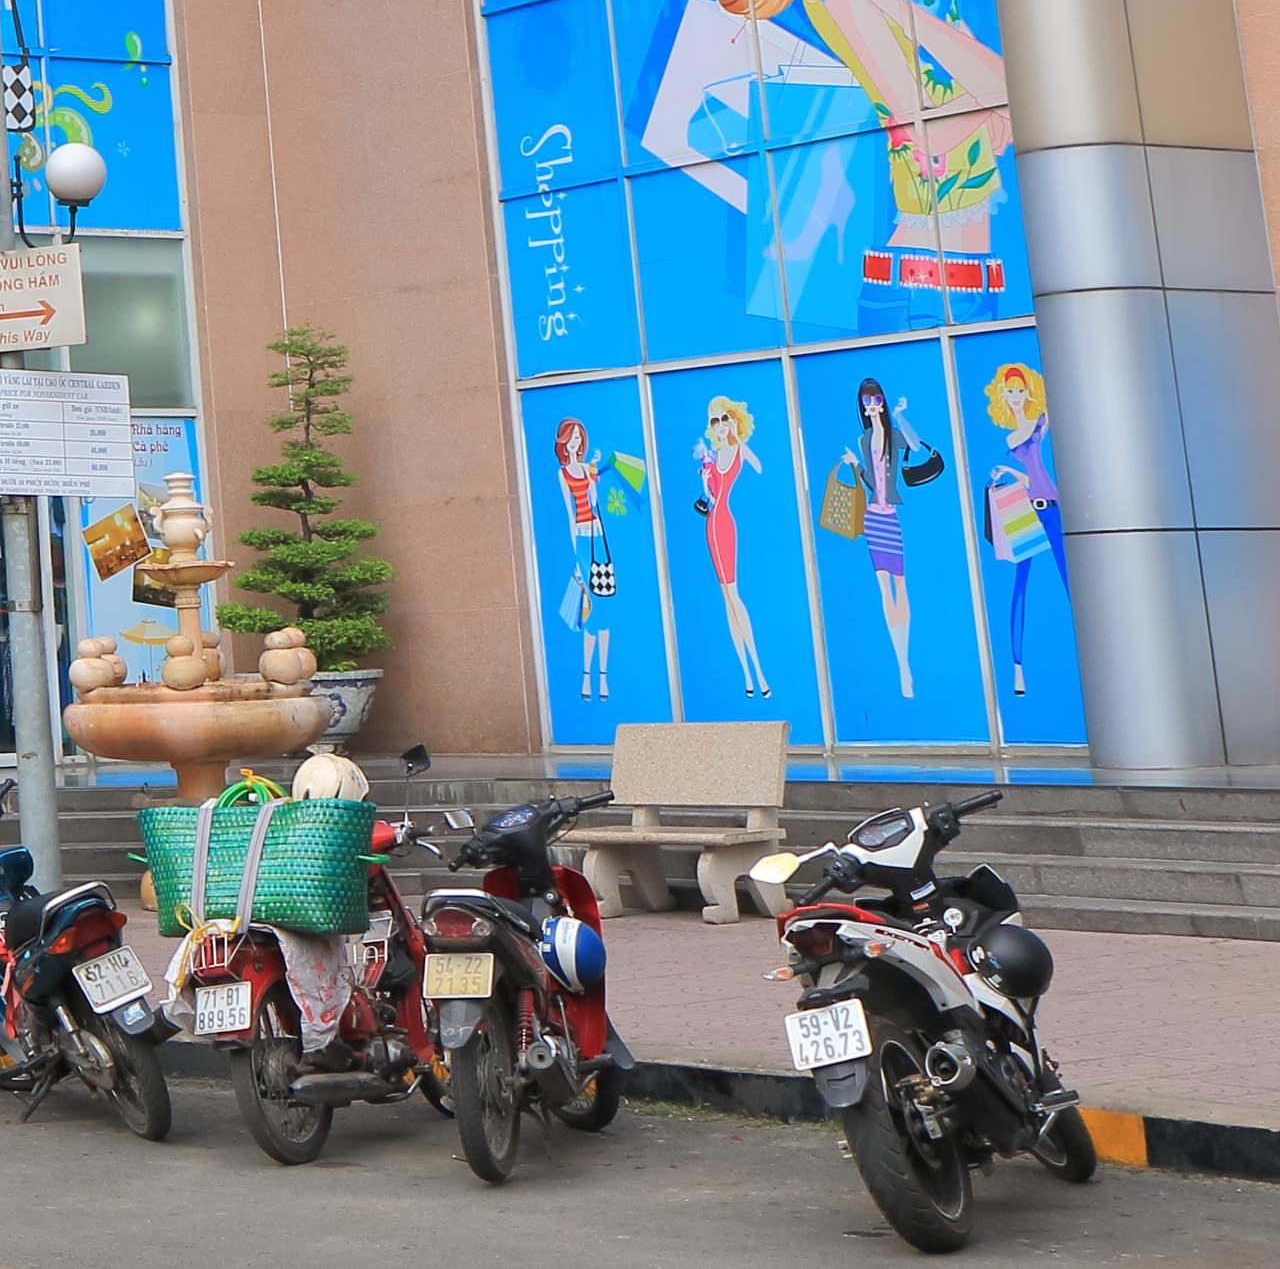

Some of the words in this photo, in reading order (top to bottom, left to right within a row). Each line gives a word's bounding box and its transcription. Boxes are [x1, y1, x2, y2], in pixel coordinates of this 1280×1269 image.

[519, 123, 574, 342] Shopping
[0, 256, 23, 270] VUI
[27, 251, 67, 268] LÒNG
[23, 330, 51, 344] Way
[68, 379, 95, 389] CENTRAL
[96, 381, 121, 390] GARDEN
[155, 423, 182, 438] hàng
[84, 953, 130, 982] 52-H4
[435, 956, 482, 975] 54-Z2
[95, 970, 138, 1001] 7116
[434, 976, 482, 995] 2135
[203, 986, 240, 1010] 71-B1
[198, 1006, 246, 1031] 889.56
[798, 1007, 854, 1038] 59-V2
[799, 1029, 865, 1065] 426.73
